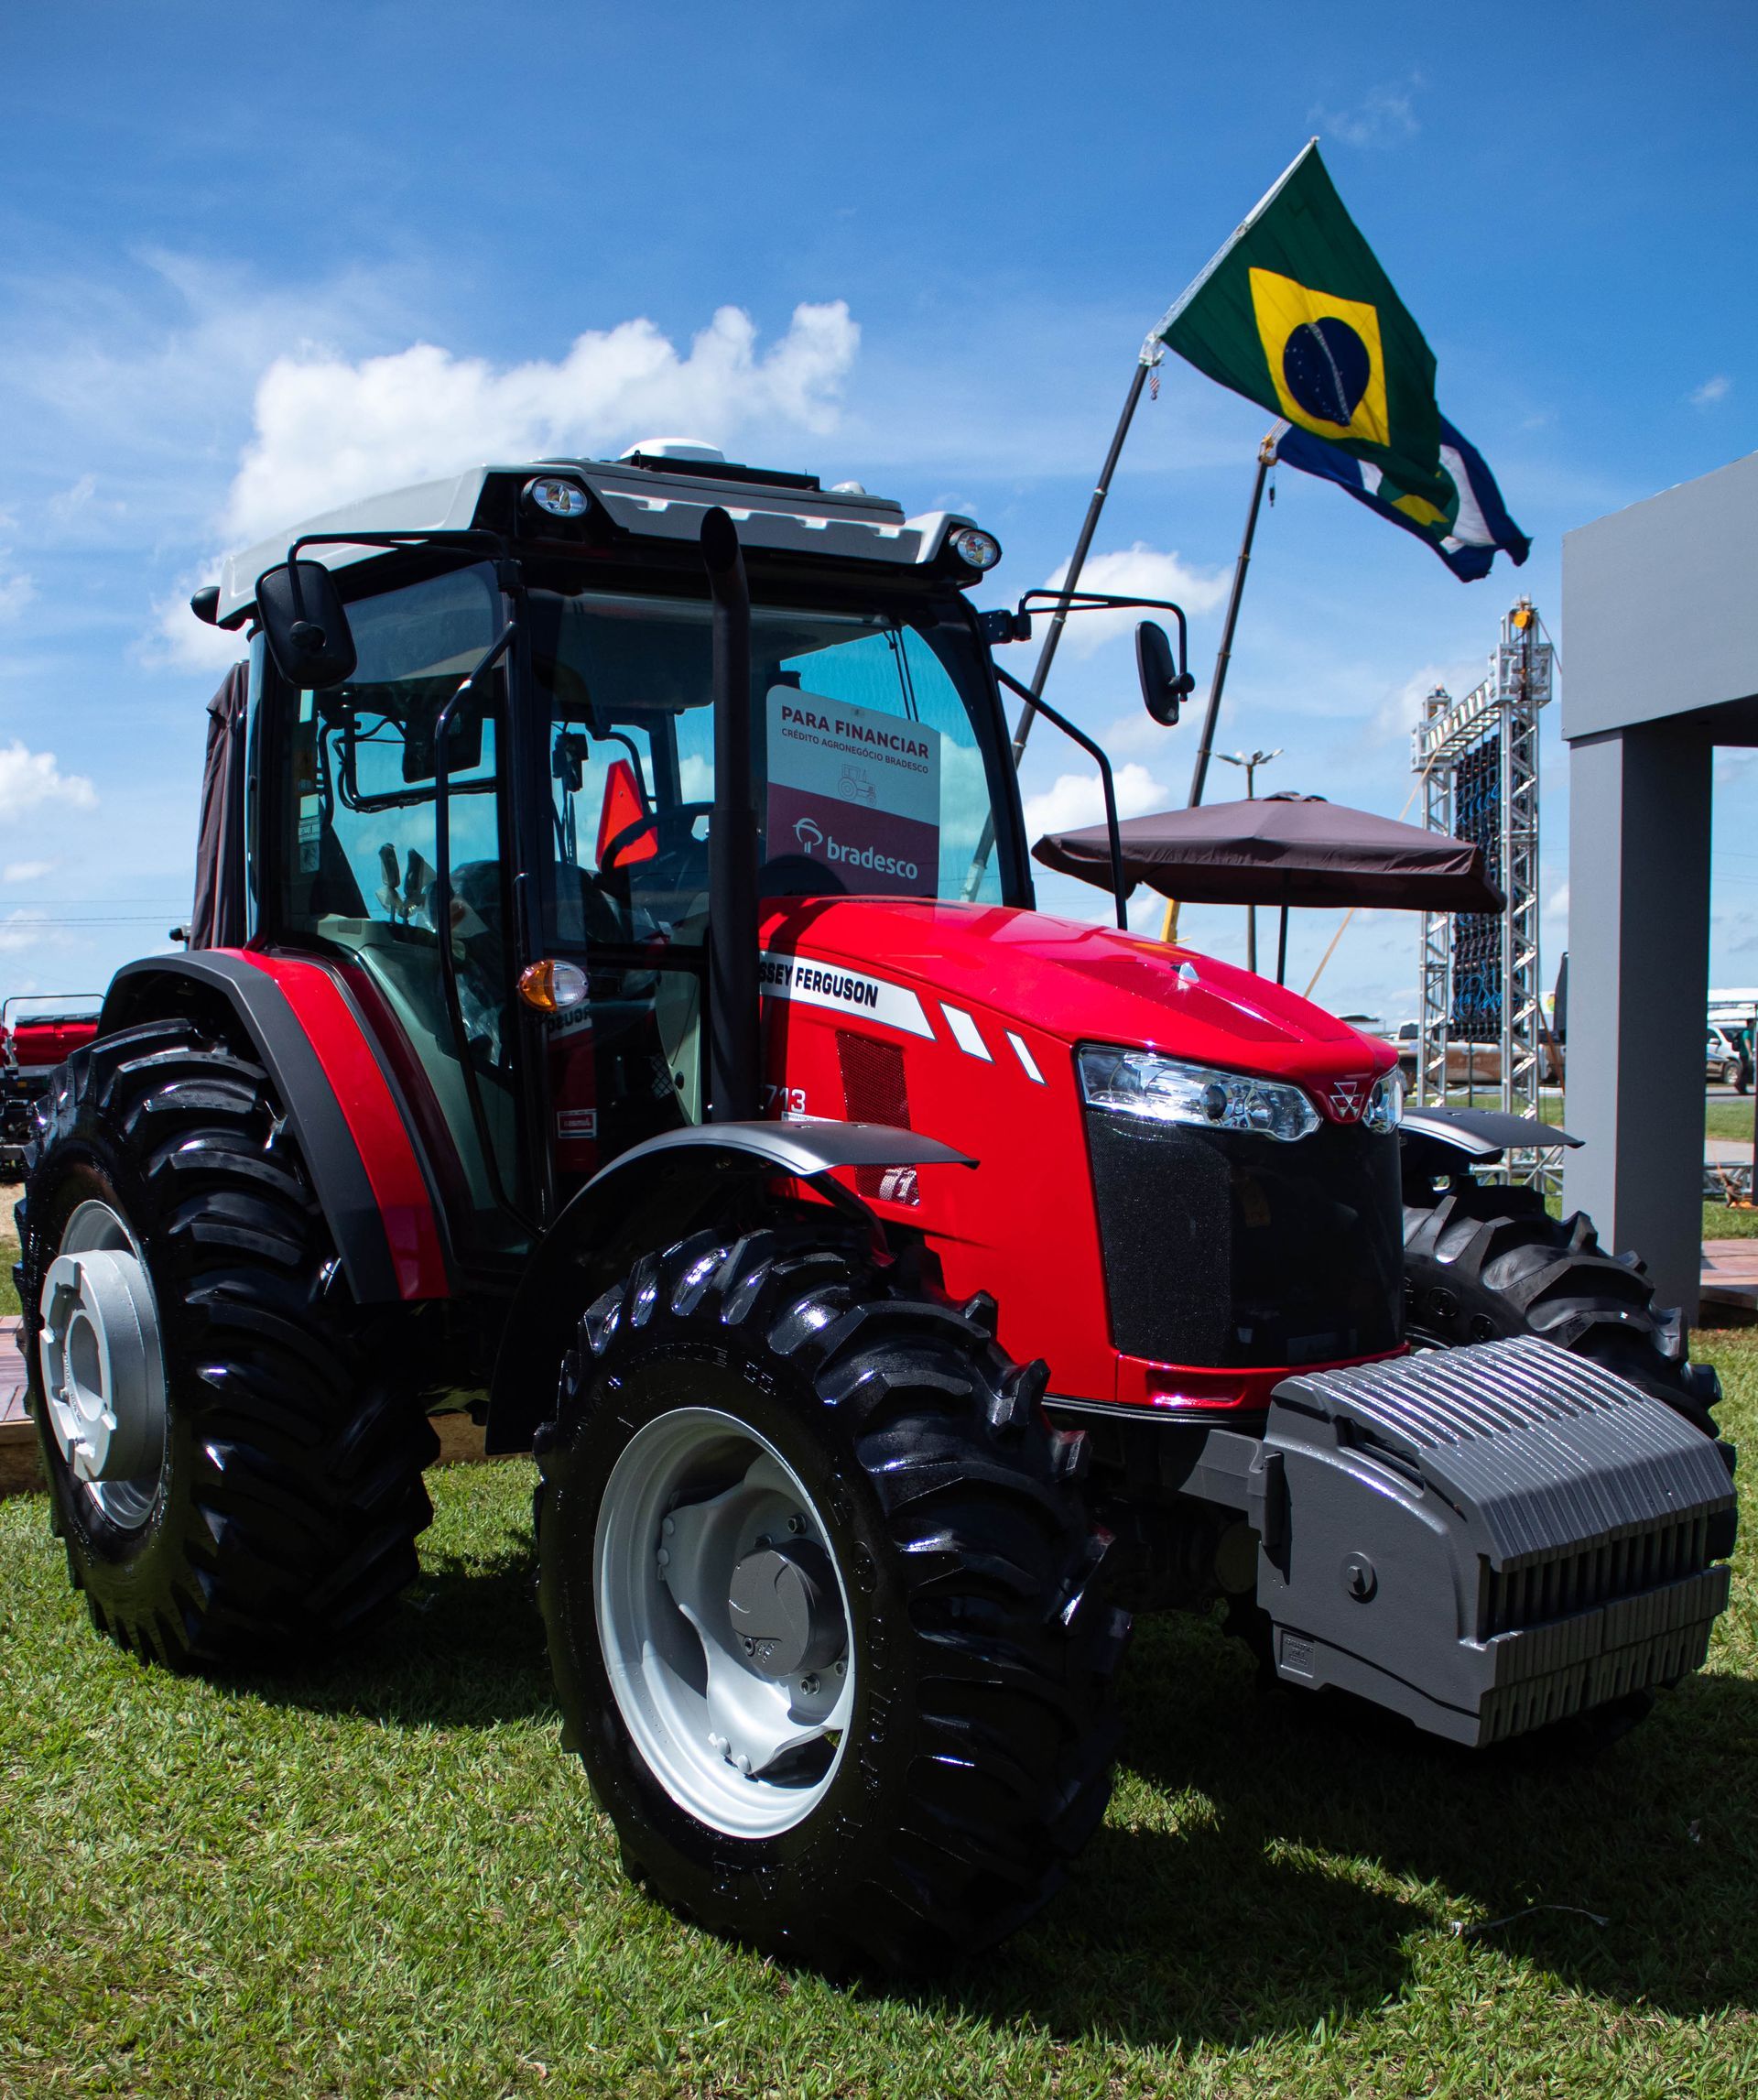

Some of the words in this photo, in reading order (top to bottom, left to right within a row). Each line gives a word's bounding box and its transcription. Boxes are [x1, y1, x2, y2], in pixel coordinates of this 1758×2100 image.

[781, 726, 819, 745] CRÉDITO
[821, 739, 884, 762] AGRONEGÓCIO
[884, 755, 928, 774] BRADESCO
[782, 705, 830, 732] PARA
[835, 720, 929, 759] FINANCIAR
[827, 835, 918, 879] bradesco
[759, 962, 793, 986] SSEY
[795, 967, 879, 1009] FERGUSON
